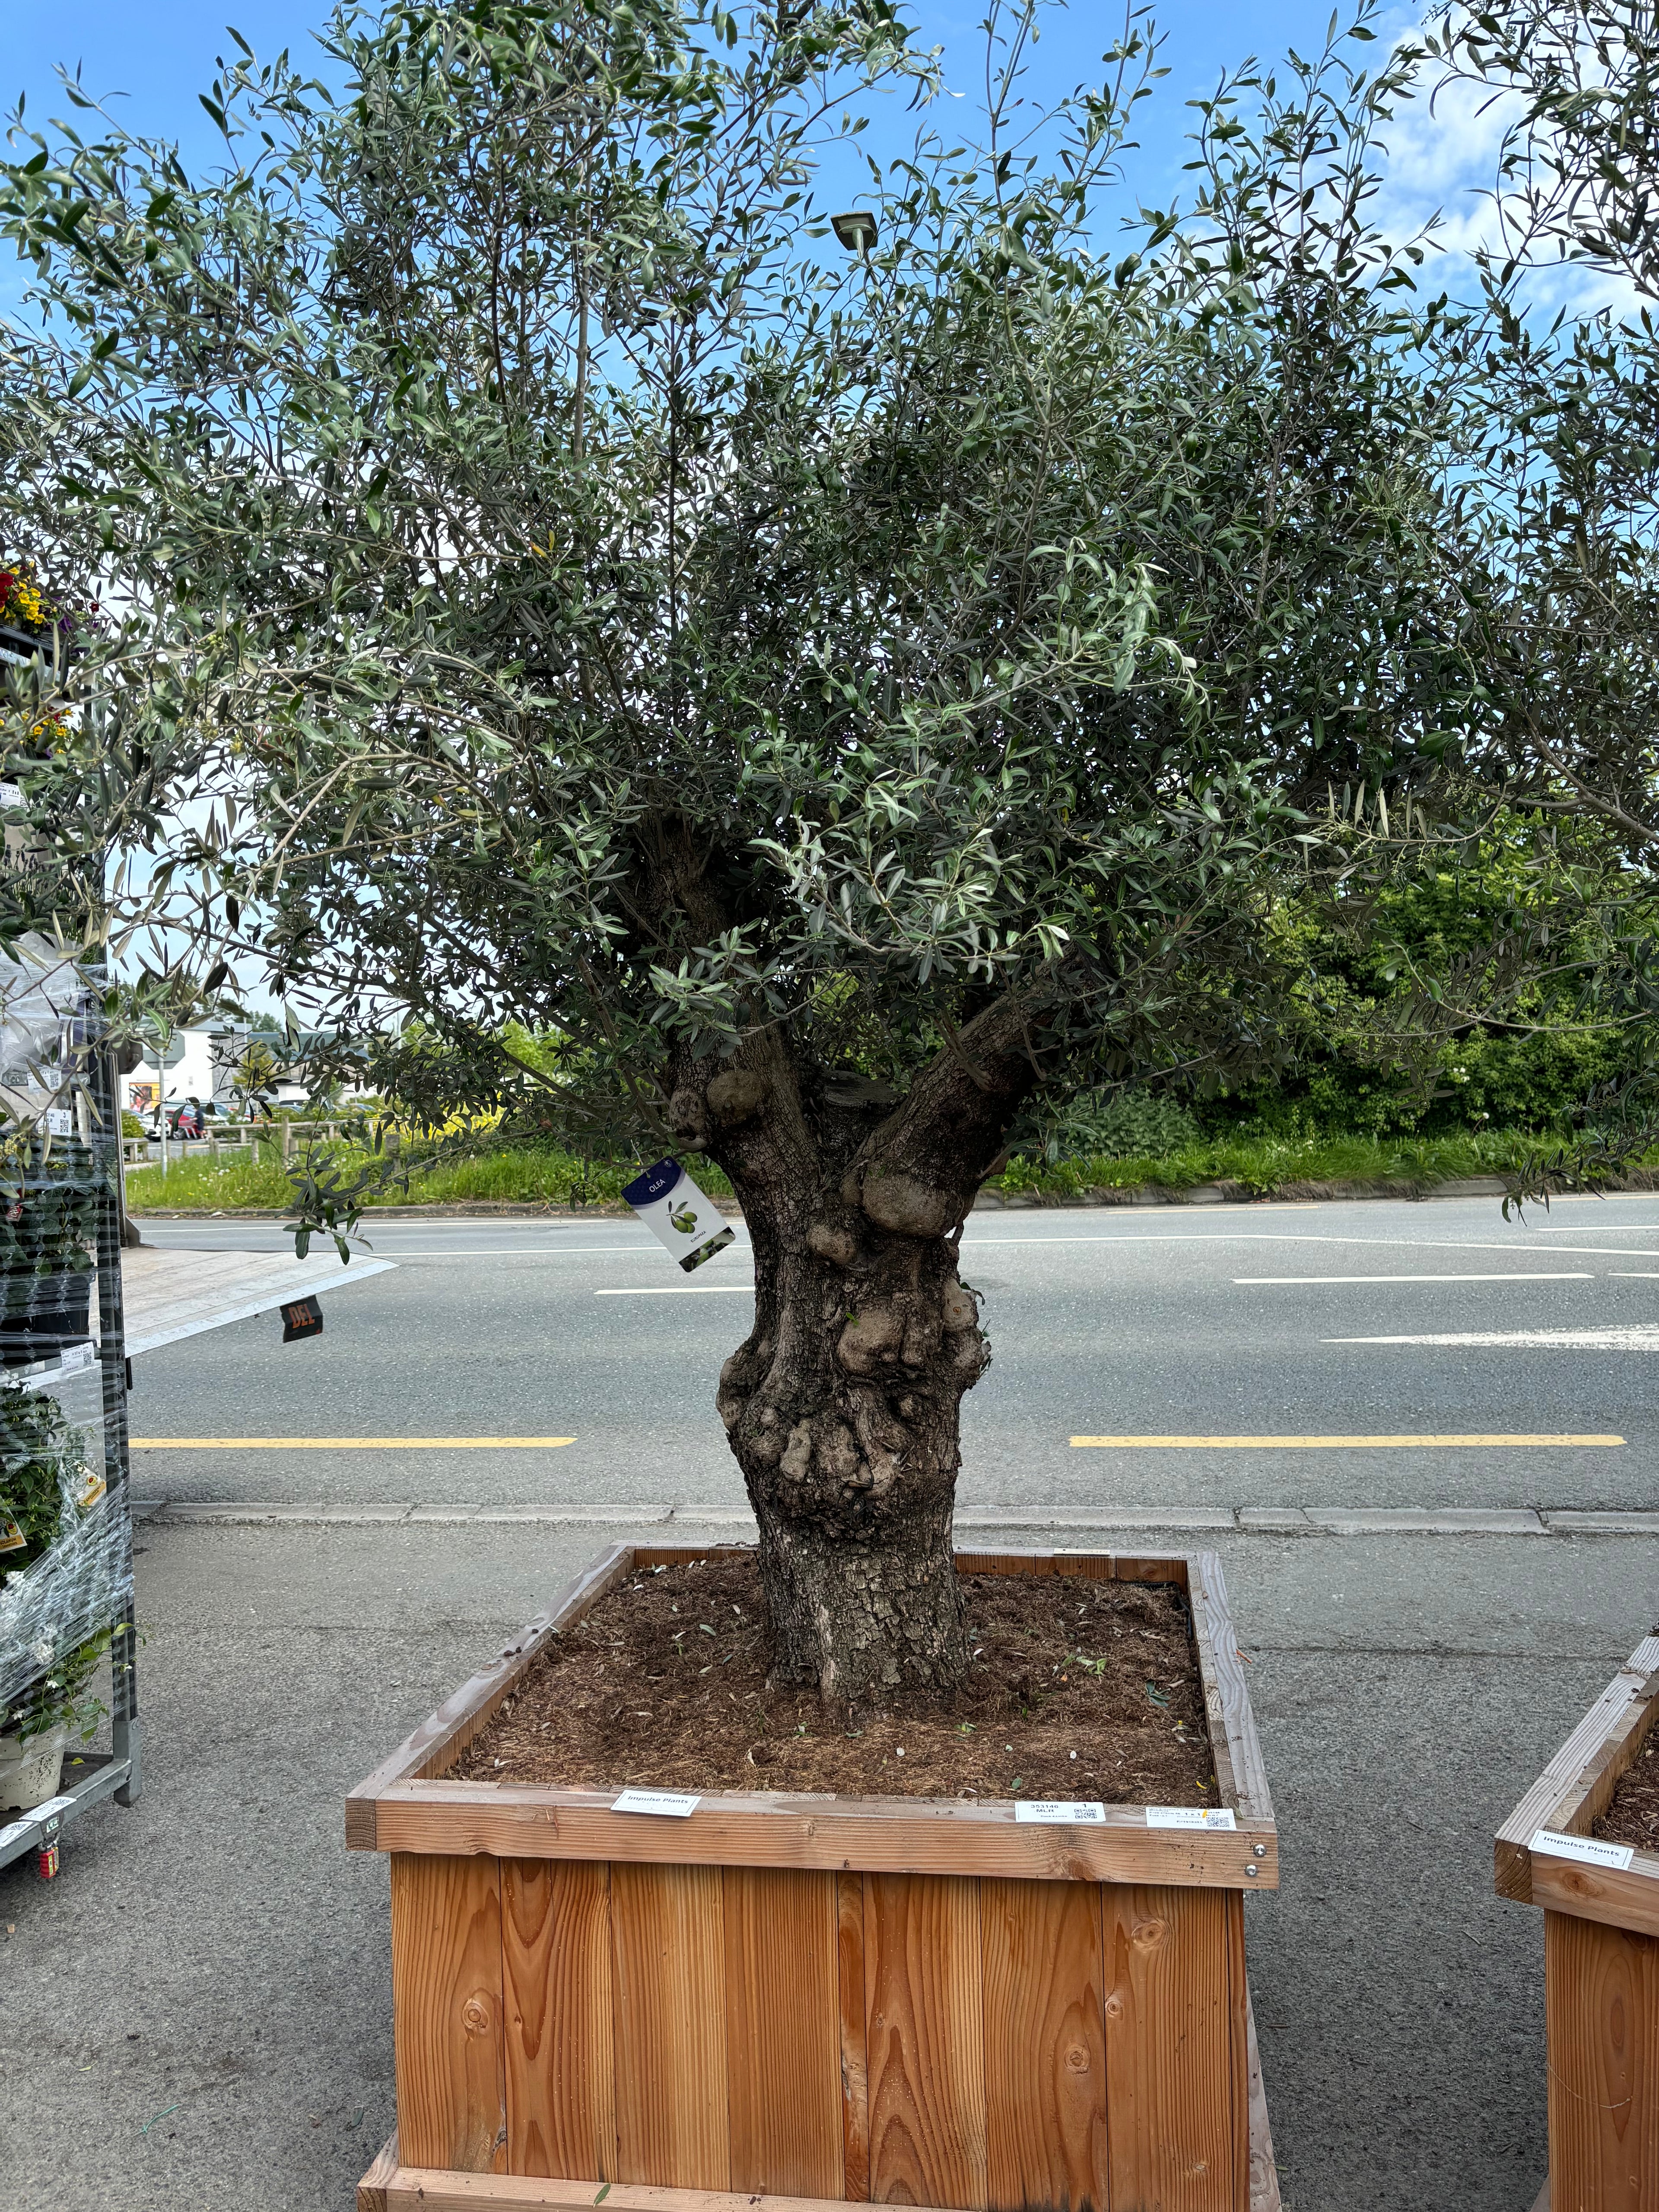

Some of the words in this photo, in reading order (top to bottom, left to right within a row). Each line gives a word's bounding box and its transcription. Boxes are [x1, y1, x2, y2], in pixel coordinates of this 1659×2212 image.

[649, 1179, 666, 1192] OLEA
[1543, 1836, 1585, 1849] Impulse
[1588, 1846, 1620, 1856] Plants
